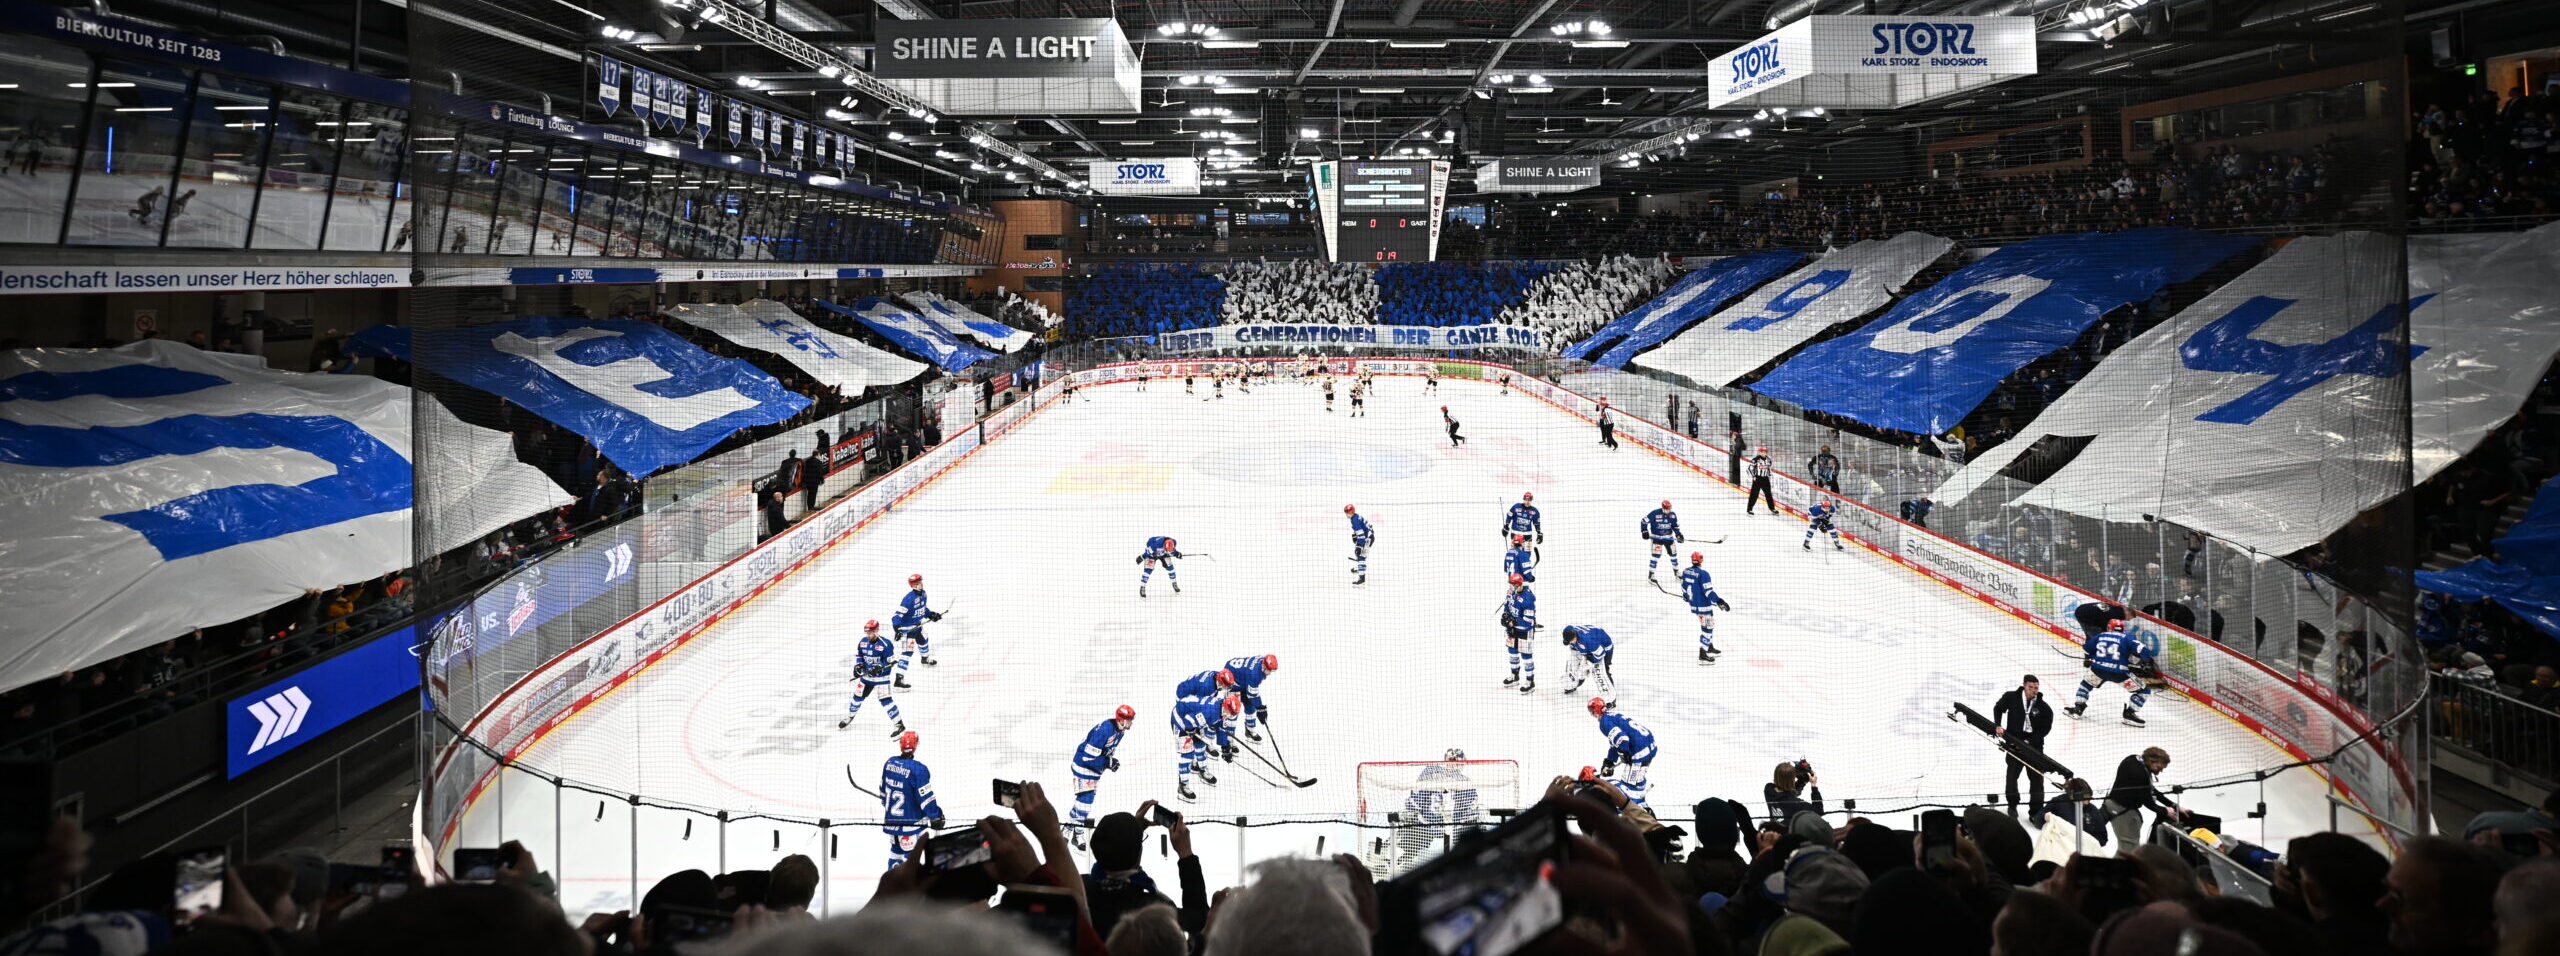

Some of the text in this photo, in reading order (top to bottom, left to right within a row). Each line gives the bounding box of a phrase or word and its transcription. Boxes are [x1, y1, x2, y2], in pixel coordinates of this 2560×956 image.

[56, 16, 221, 62] BIERKULTUR SEIT 1283
[893, 36, 1097, 59] SHINE A LIGHT
[1872, 22, 1975, 56] STORZ
[1732, 38, 1780, 83] STORZ
[1862, 57, 1988, 67] KARL STORZ ENDOSKOPE
[604, 61, 617, 85] 17
[635, 71, 650, 93] 20
[1757, 68, 1786, 86] ENDOSKOPE
[655, 79, 667, 100] 21
[672, 83, 684, 105] 22
[698, 92, 709, 113] 24
[548, 119, 575, 134] LOUNGE
[603, 132, 635, 146] BIERKULTUR
[1117, 163, 1165, 179] STORZ
[1506, 167, 1593, 177] SHINE A LIGHT
[1370, 219, 1377, 228] 0
[1399, 219, 1406, 228] 0
[0, 270, 399, 290] enschaft lassen unser Herz höher schlagen.
[571, 268, 593, 280] STORZ
[1161, 332, 1213, 351] ÜBER
[1235, 326, 1377, 343] GENERATIONEN
[1392, 328, 1431, 345] DER
[1446, 326, 1499, 345] GANZE
[1869, 273, 2054, 355] 0
[2178, 292, 2439, 427] 4
[491, 326, 761, 432] E
[832, 441, 860, 463] kabeltec
[1905, 539, 2019, 600] Schwarzwälder Bote
[2096, 641, 2121, 661] 54
